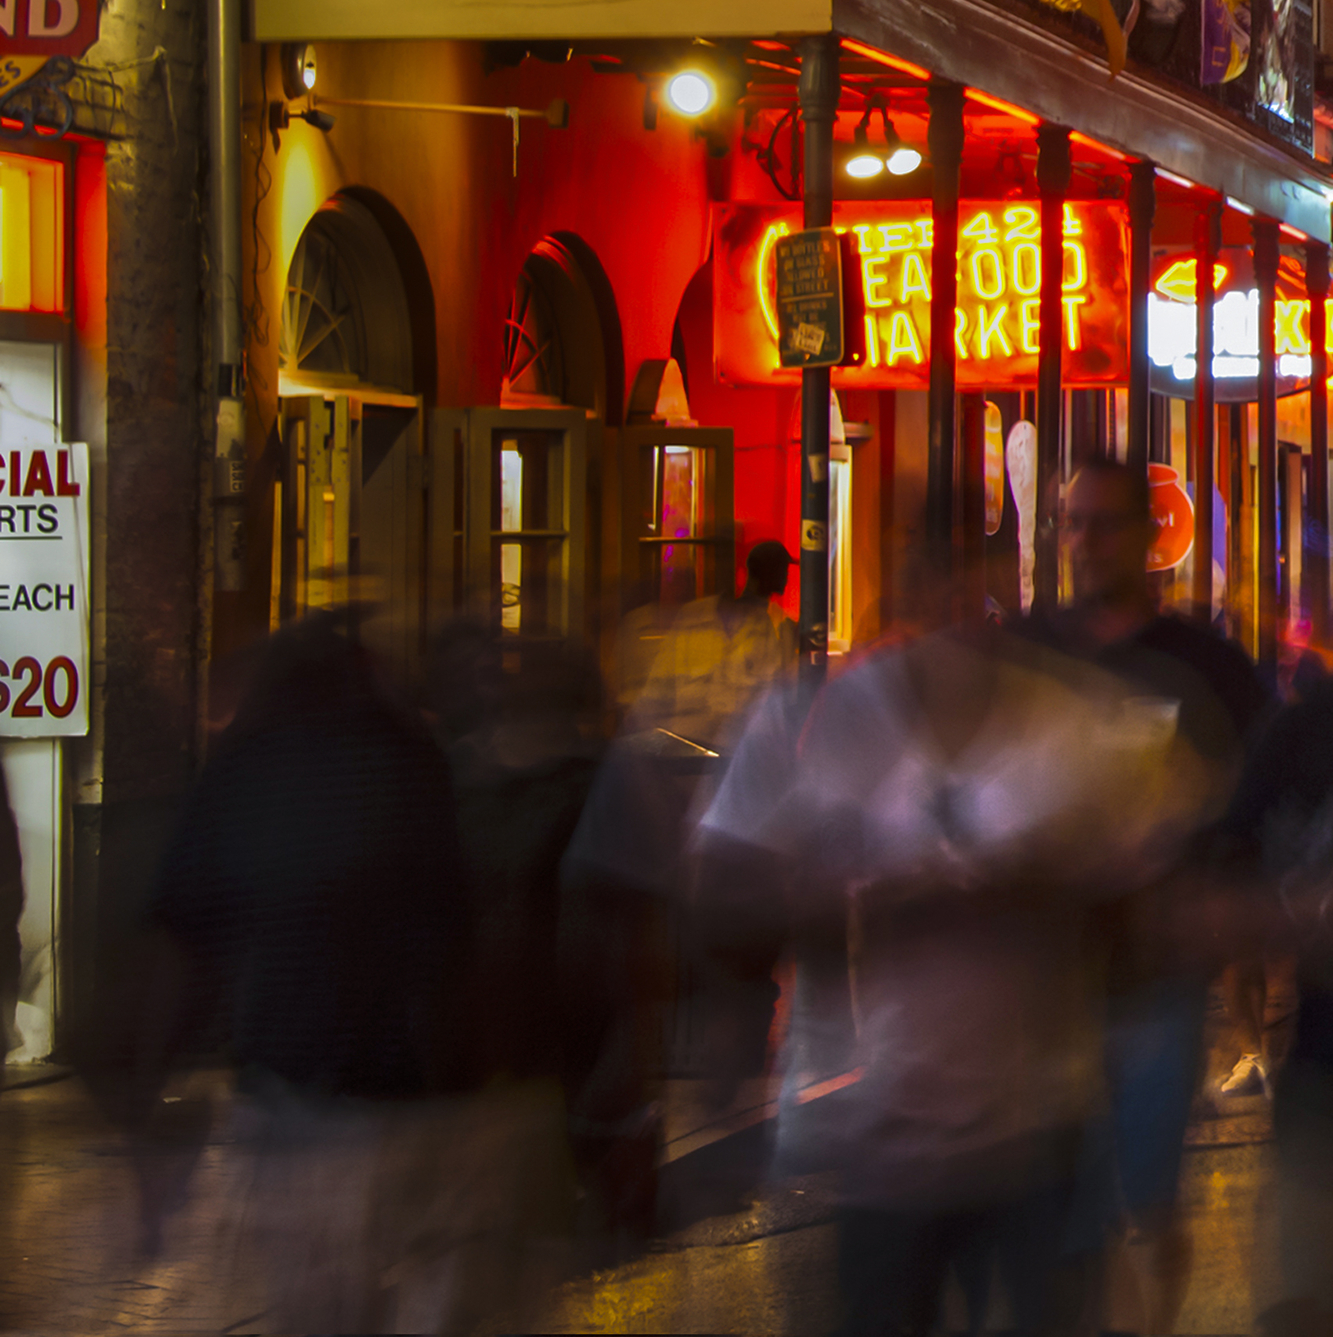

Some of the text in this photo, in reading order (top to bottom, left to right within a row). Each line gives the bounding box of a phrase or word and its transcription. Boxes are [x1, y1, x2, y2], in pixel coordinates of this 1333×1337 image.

[863, 241, 1087, 307] EAOOD
[864, 297, 1086, 366] AKET
[0, 449, 80, 497] IAL
